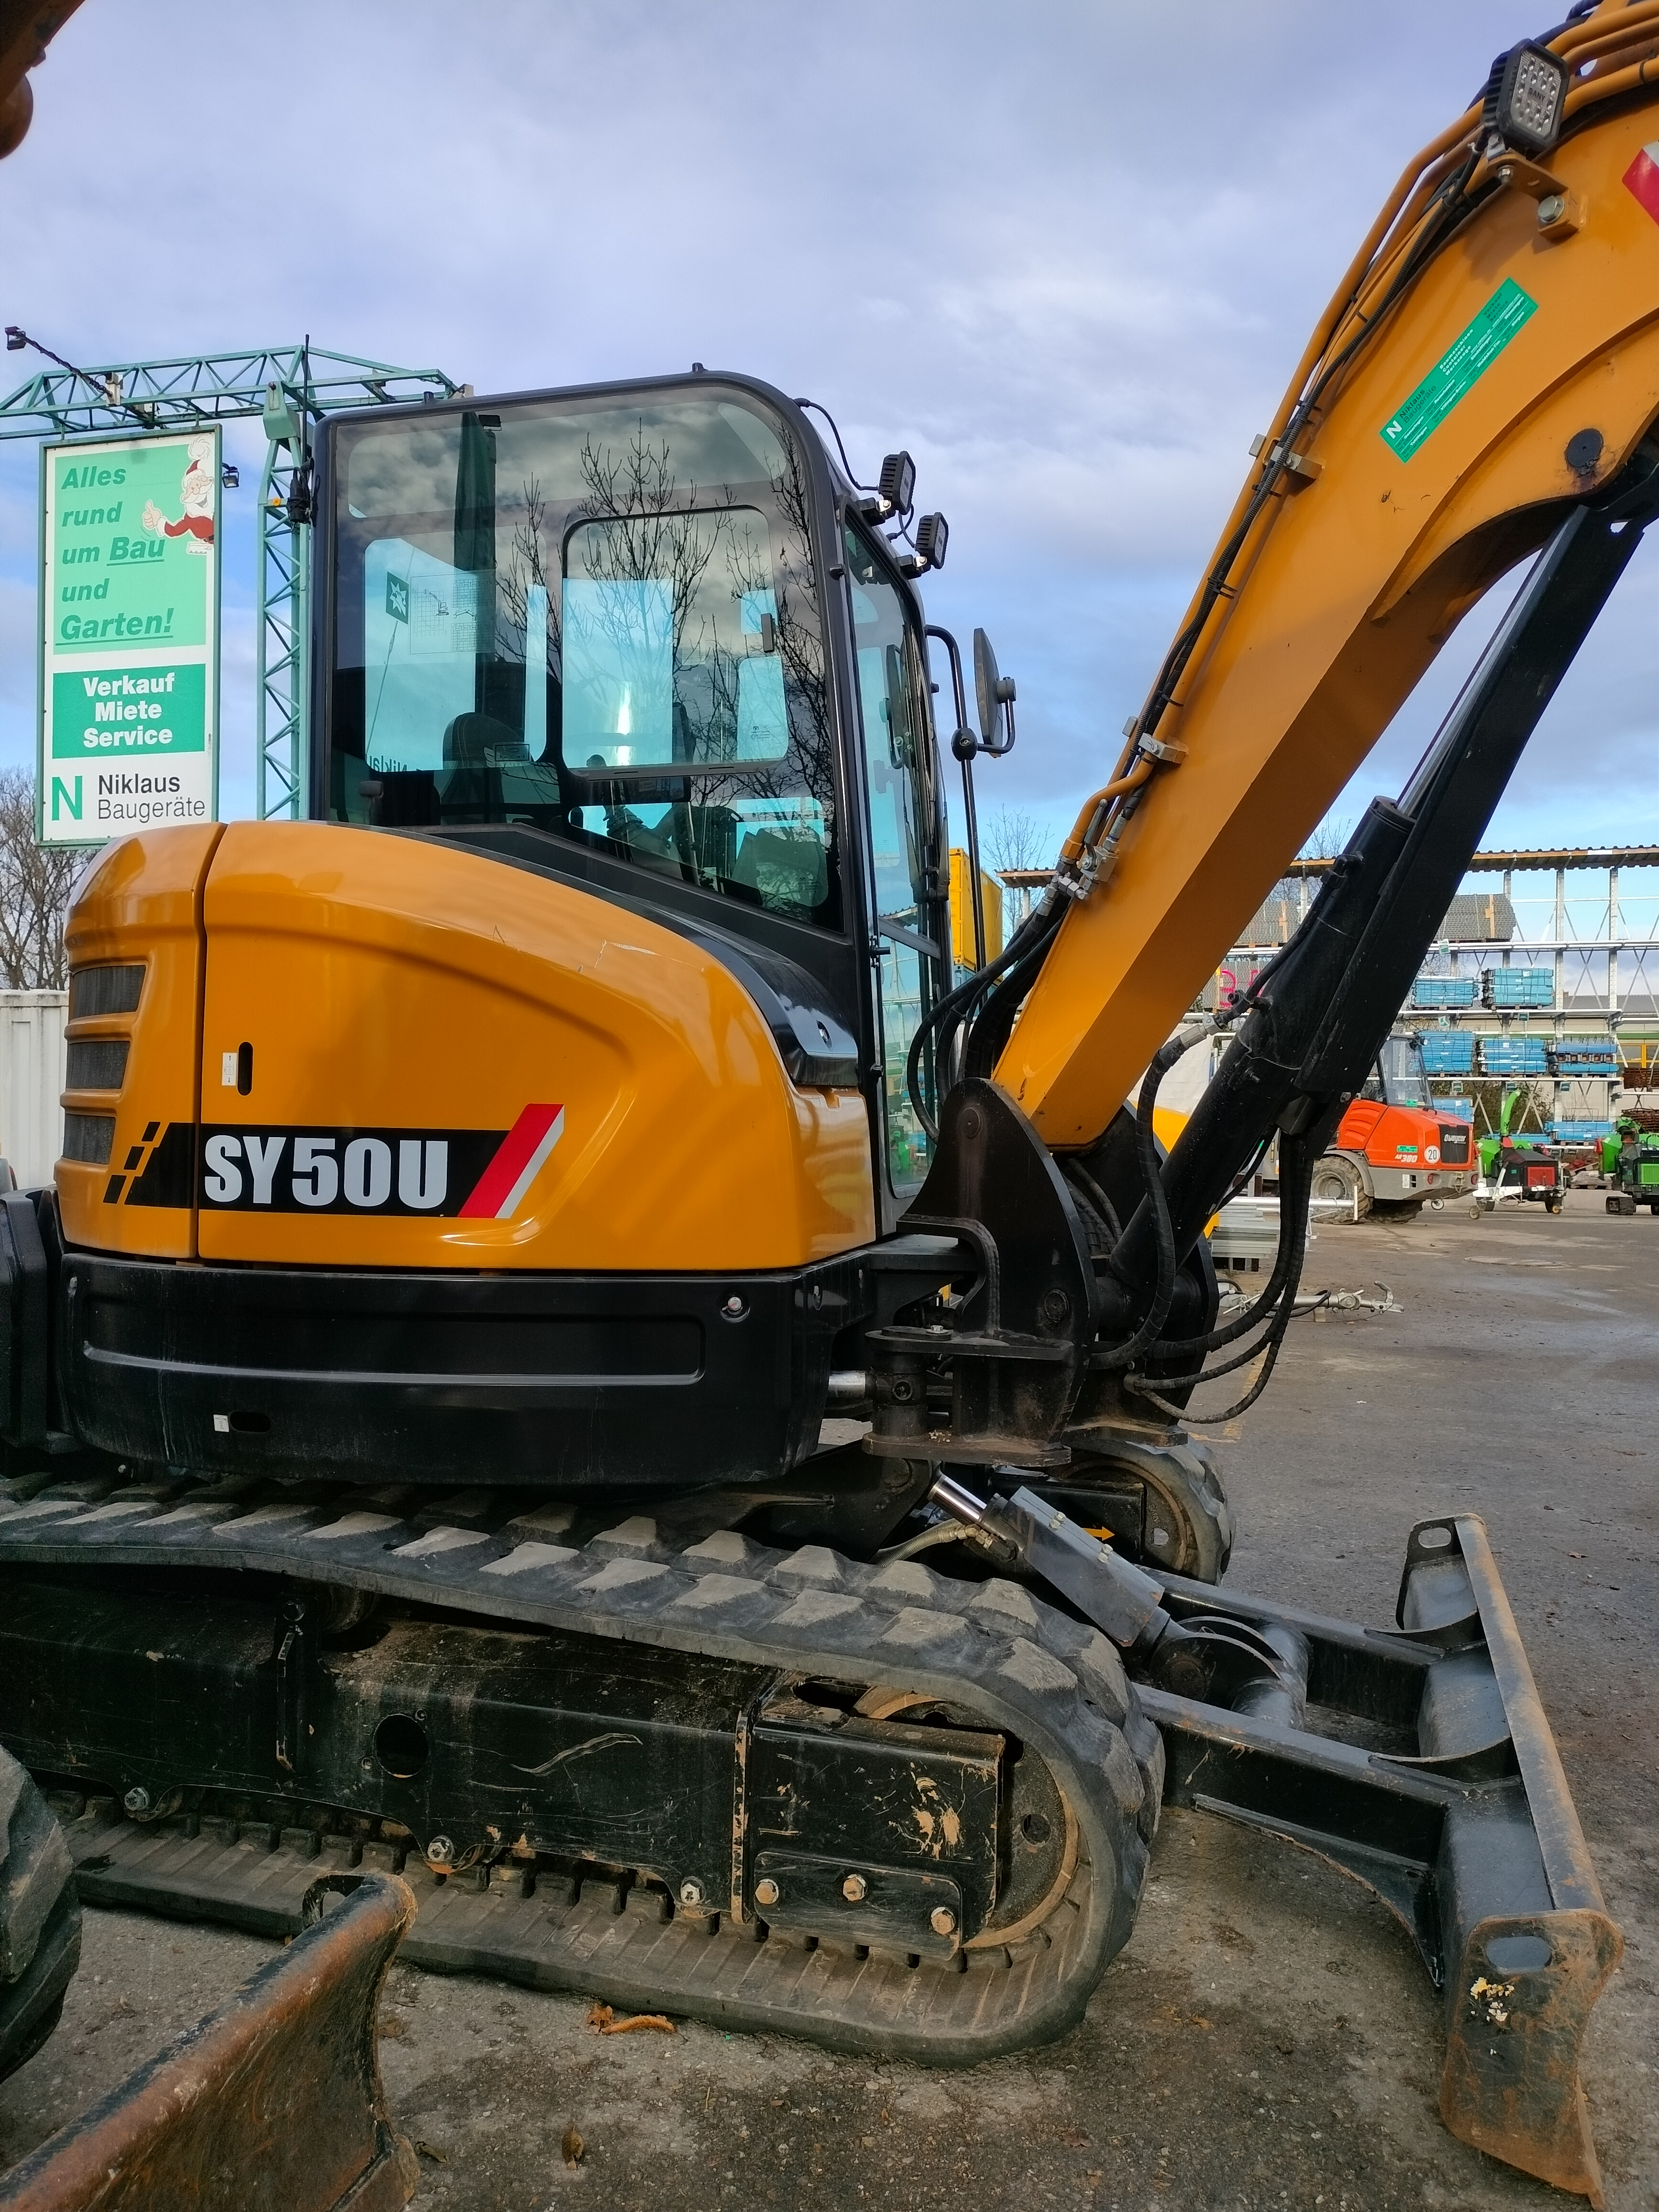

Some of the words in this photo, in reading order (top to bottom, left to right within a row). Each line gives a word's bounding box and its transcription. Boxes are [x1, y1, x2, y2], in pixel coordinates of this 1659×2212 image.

[1528, 88, 1546, 101] SANY
[1482, 292, 1502, 316] Verkauf
[1486, 302, 1501, 319] Miete
[1489, 299, 1508, 322] Service
[1439, 328, 1473, 369] Baumaschinen
[1442, 344, 1466, 373] Container
[1445, 344, 1471, 376] Werkzeuge
[1399, 387, 1425, 419] Niklaus
[1403, 384, 1438, 424] Baugeräte
[1386, 420, 1402, 439] N
[61, 465, 126, 489] Alles
[62, 501, 123, 527] rund
[62, 546, 100, 565] um
[109, 536, 165, 561] Bau
[62, 578, 110, 602] und
[61, 608, 174, 640] Garten!
[83, 672, 175, 697] Verkauf
[95, 700, 162, 722] Miete
[83, 725, 173, 748] Service
[98, 773, 180, 795] Niklaus
[52, 775, 83, 821] N
[98, 796, 205, 823] Baugeräte
[1428, 1149, 1437, 1160] 20
[205, 1135, 448, 1209] SY50U
